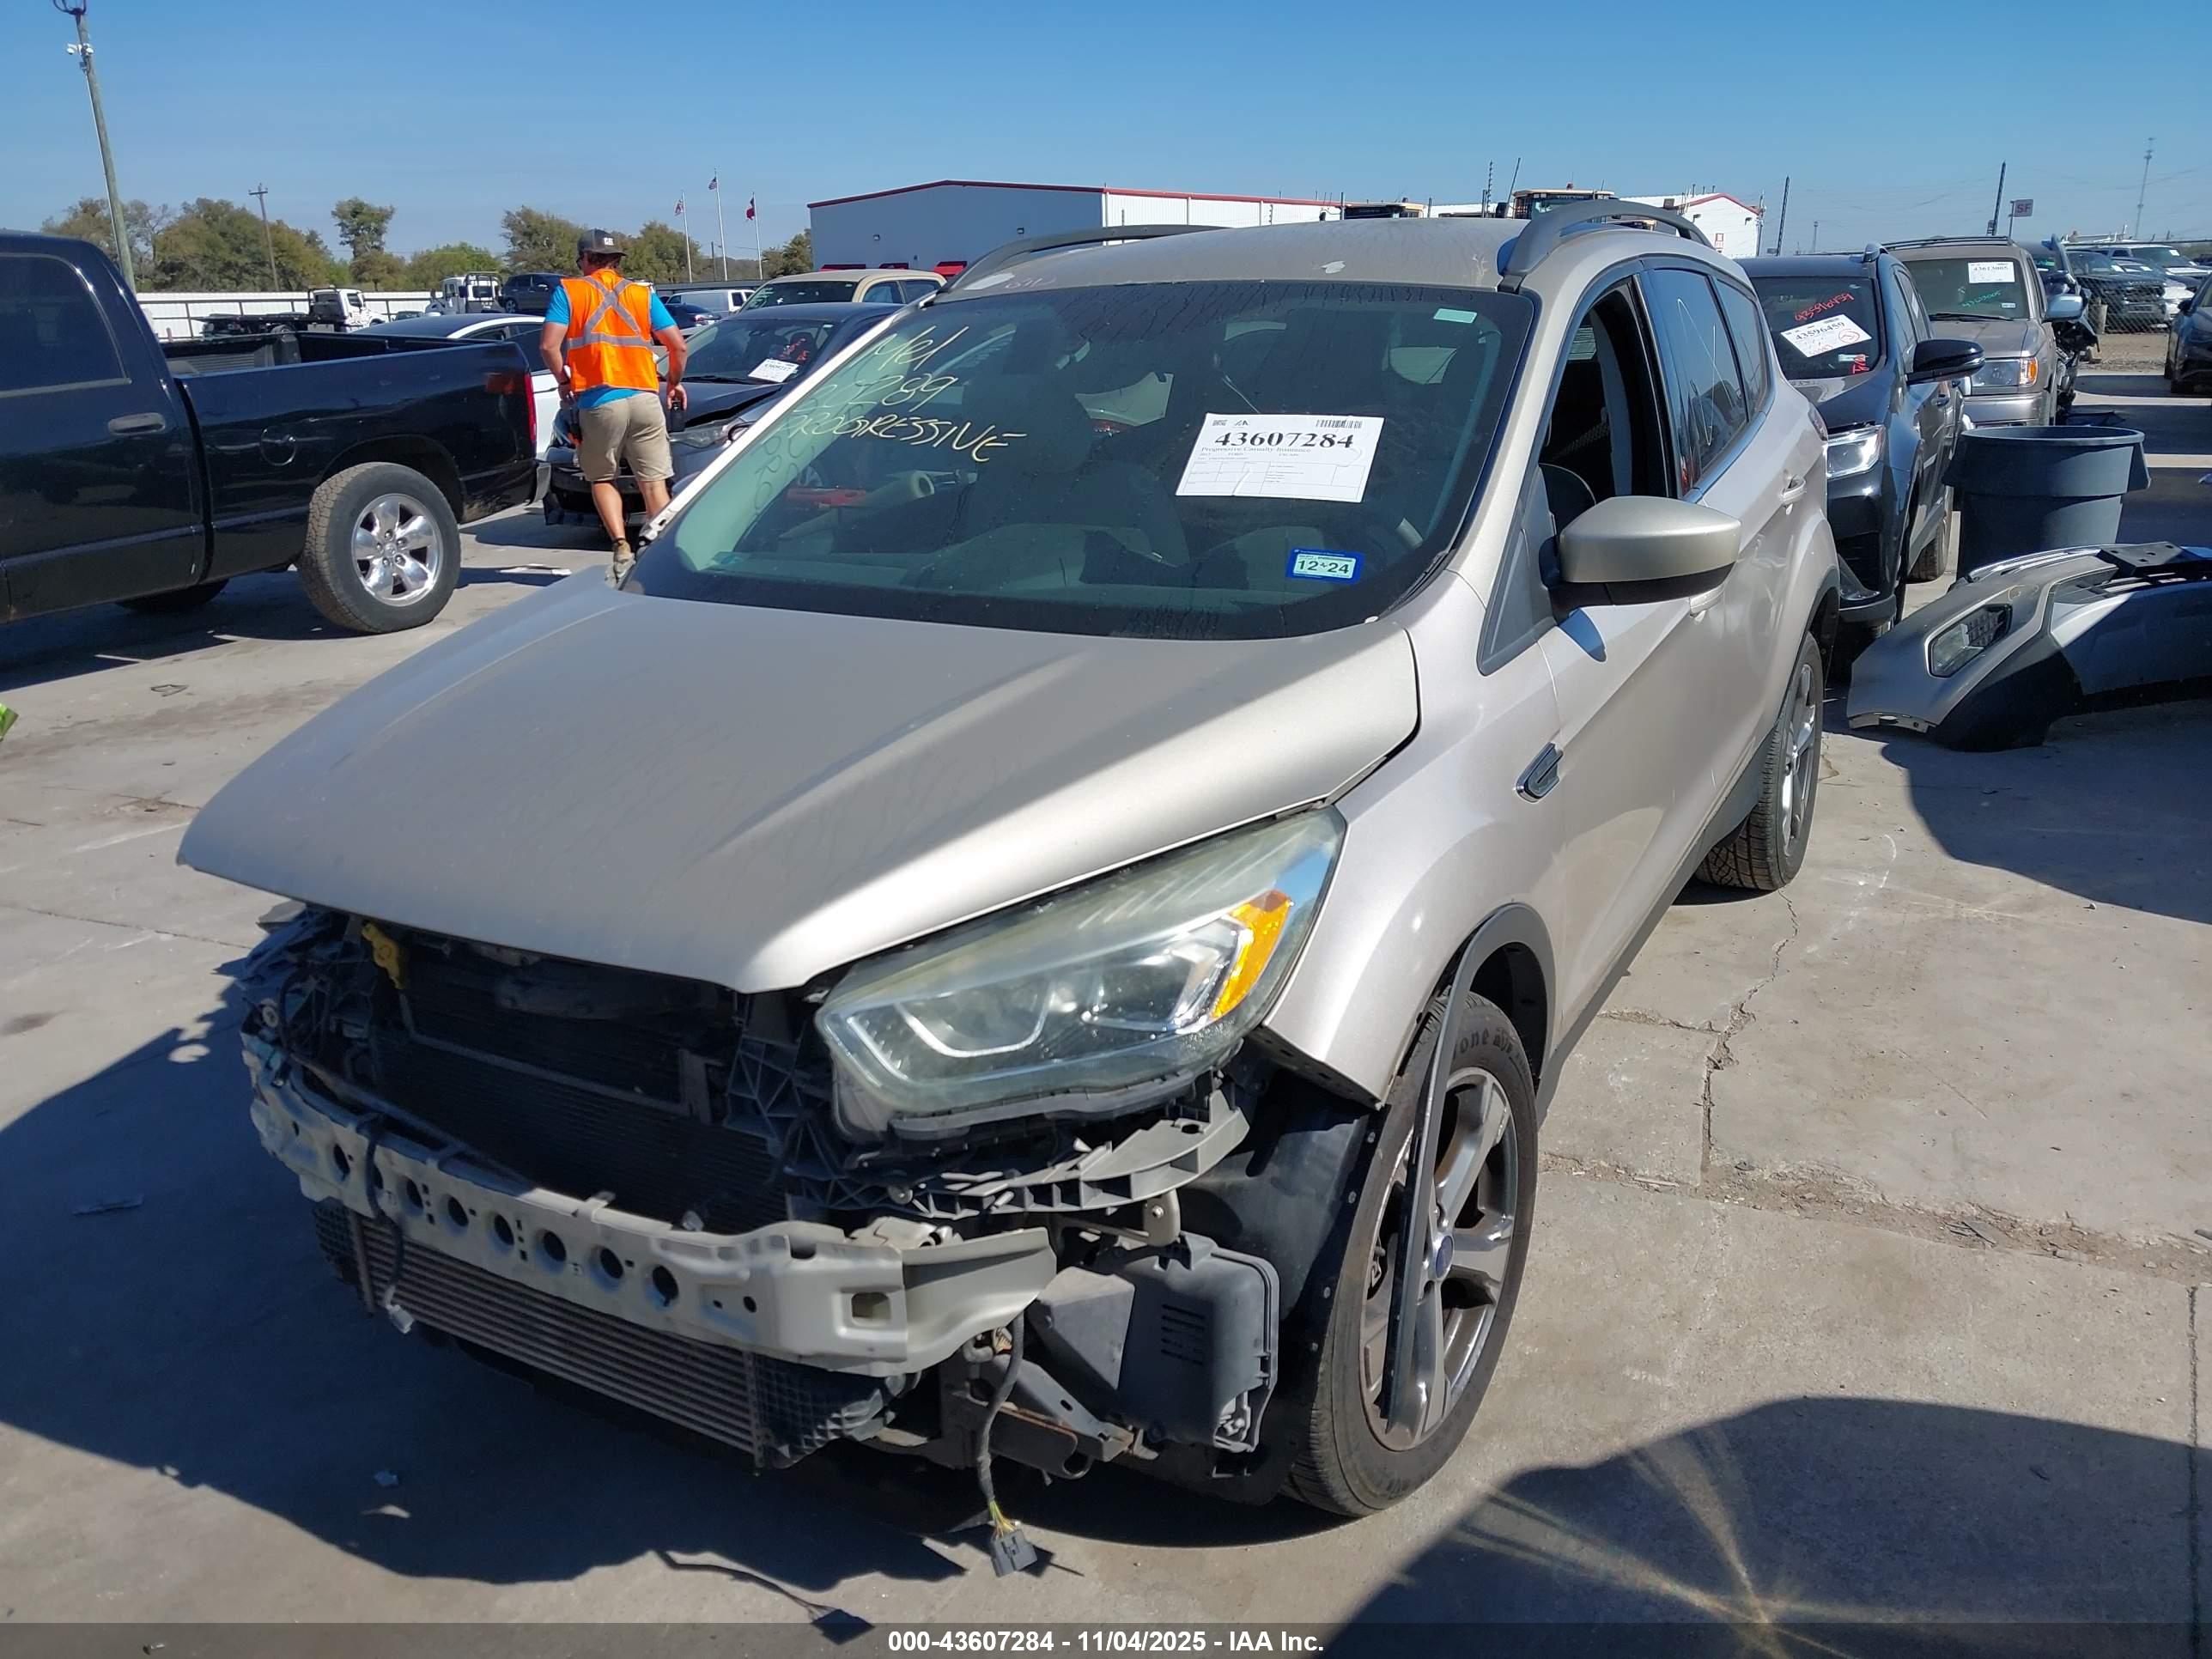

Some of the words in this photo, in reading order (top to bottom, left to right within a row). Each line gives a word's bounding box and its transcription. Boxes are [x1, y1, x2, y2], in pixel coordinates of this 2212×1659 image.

[1796, 321, 1845, 340] 43596459
[763, 414, 1028, 462] PROGRESSIVE
[1214, 431, 1354, 448] 43607284
[1297, 560, 1319, 571] 12
[1327, 562, 1349, 574] 24
